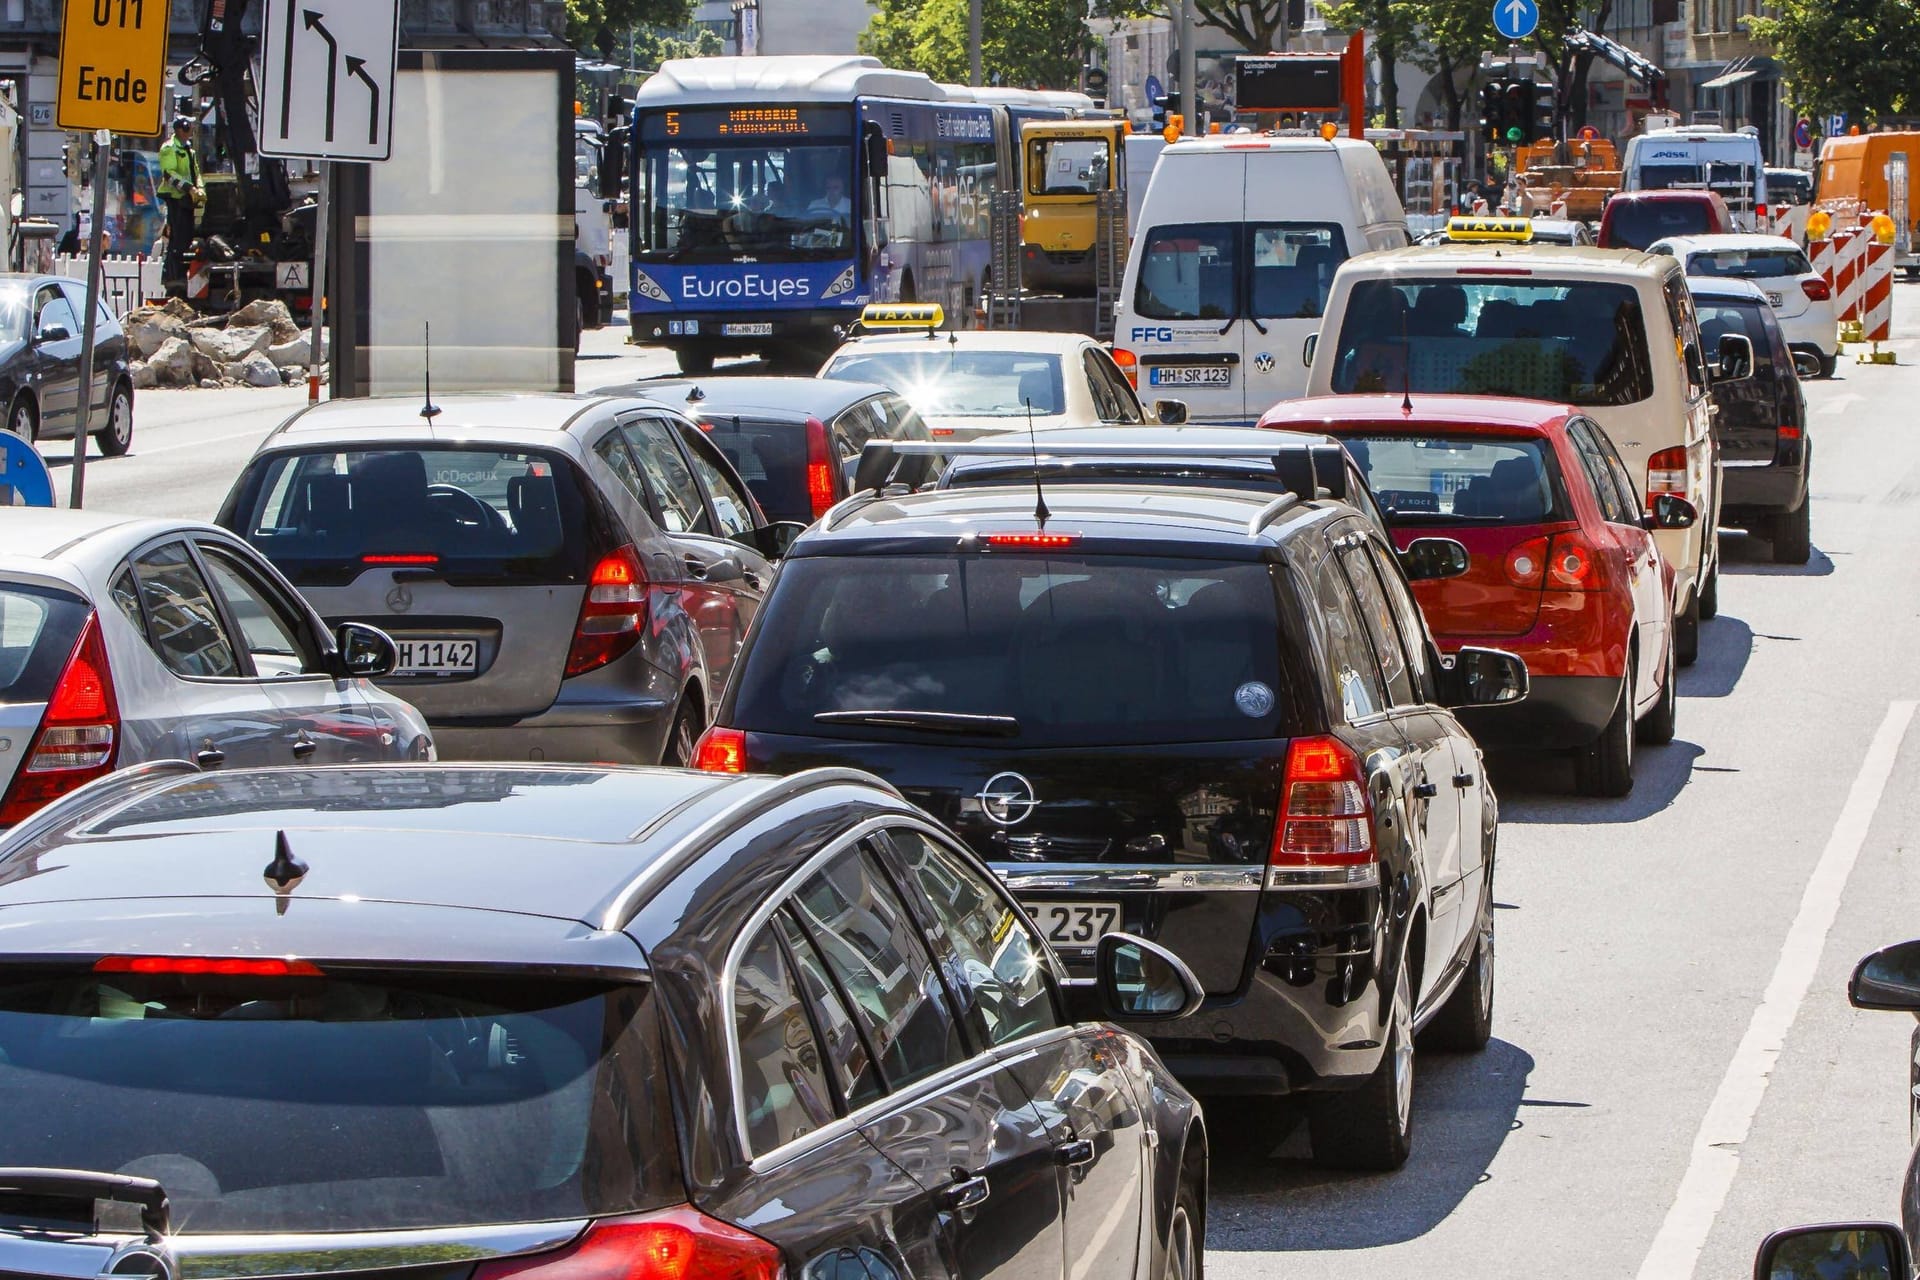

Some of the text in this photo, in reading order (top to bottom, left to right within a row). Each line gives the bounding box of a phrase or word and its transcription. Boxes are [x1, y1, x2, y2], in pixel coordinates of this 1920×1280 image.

[77, 66, 147, 104] Ende
[666, 109, 798, 135] 5 METROBUS
[1463, 221, 1517, 232] TAXI
[682, 274, 810, 302] EuroEyes
[874, 310, 926, 321] TAXI
[1131, 327, 1172, 342] FFG
[1159, 368, 1228, 382] HH SR 123
[432, 470, 499, 483] JCDecaux
[418, 643, 473, 667] 1142
[1049, 907, 1117, 942] 237
